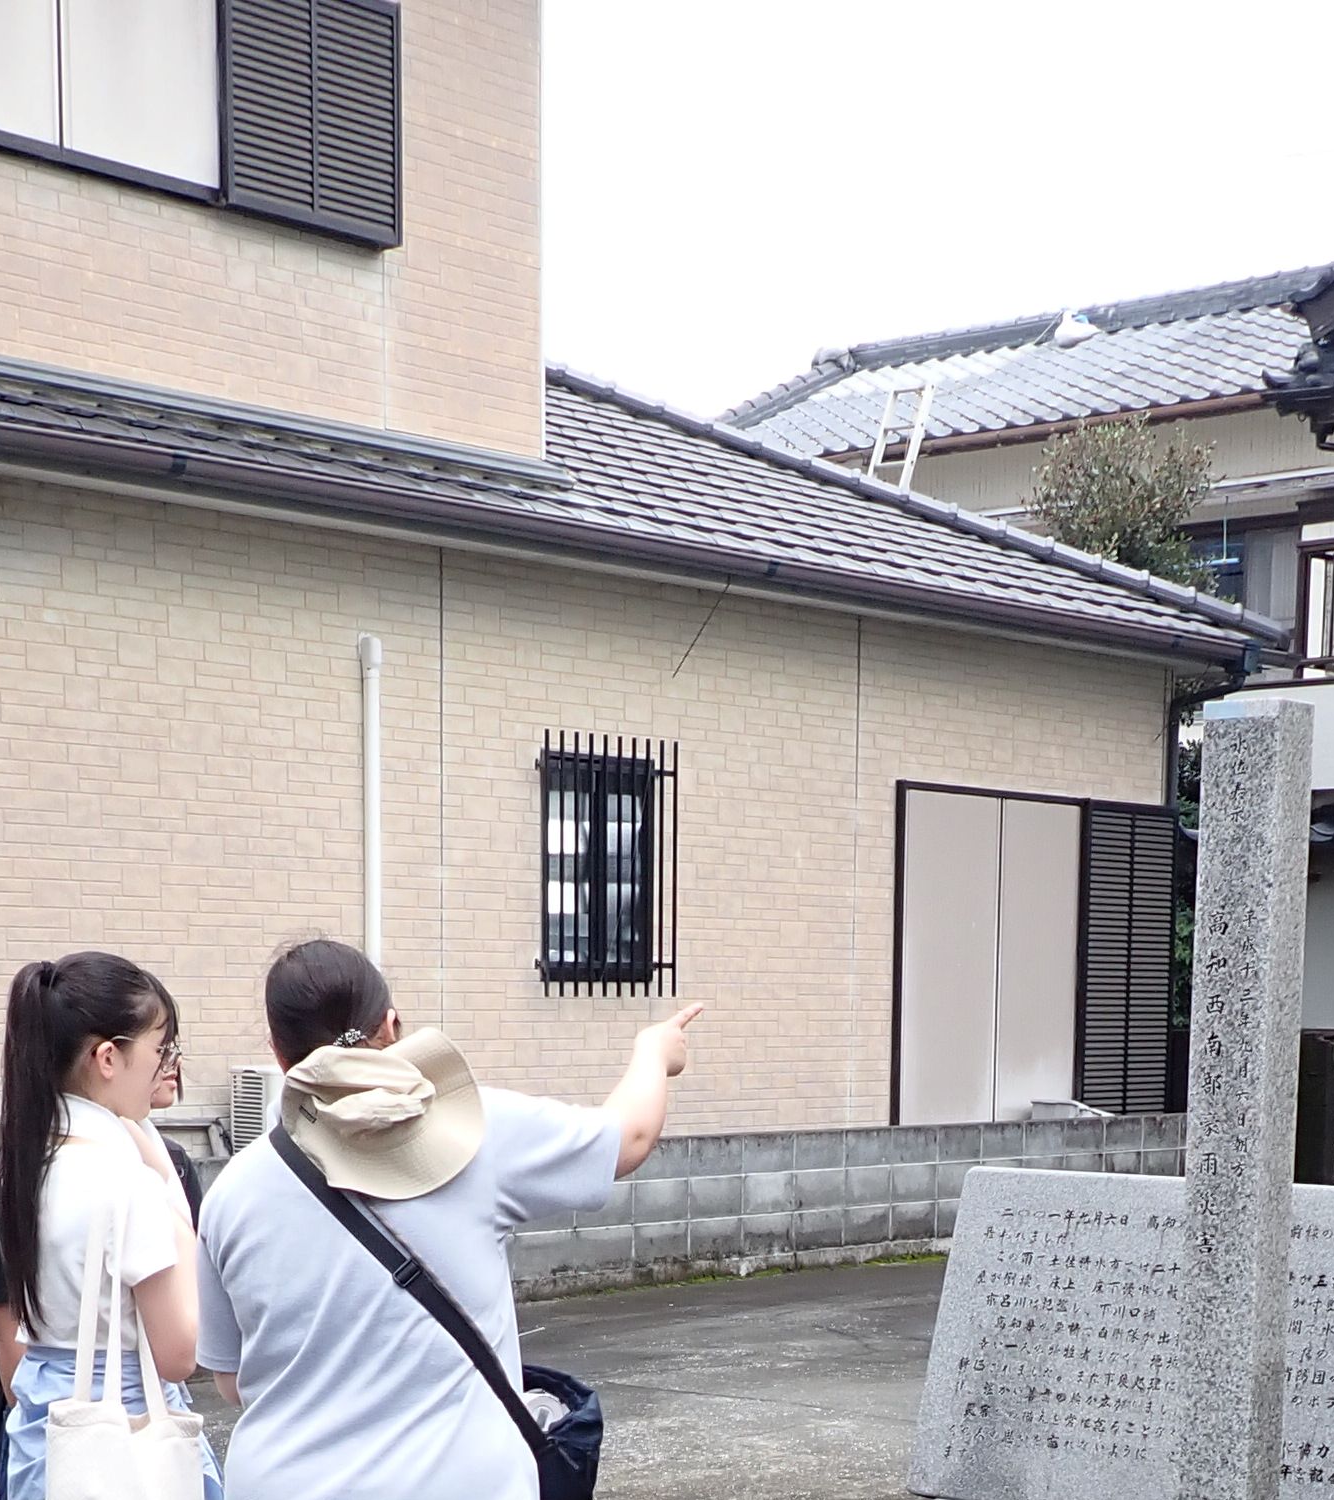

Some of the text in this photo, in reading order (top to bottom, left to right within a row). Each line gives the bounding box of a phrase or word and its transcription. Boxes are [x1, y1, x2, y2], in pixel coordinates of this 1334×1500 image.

[1194, 910, 1229, 1254] 高知西南部豪雨災害
[1231, 909, 1258, 1177] 平成十三年九月六日朝方
